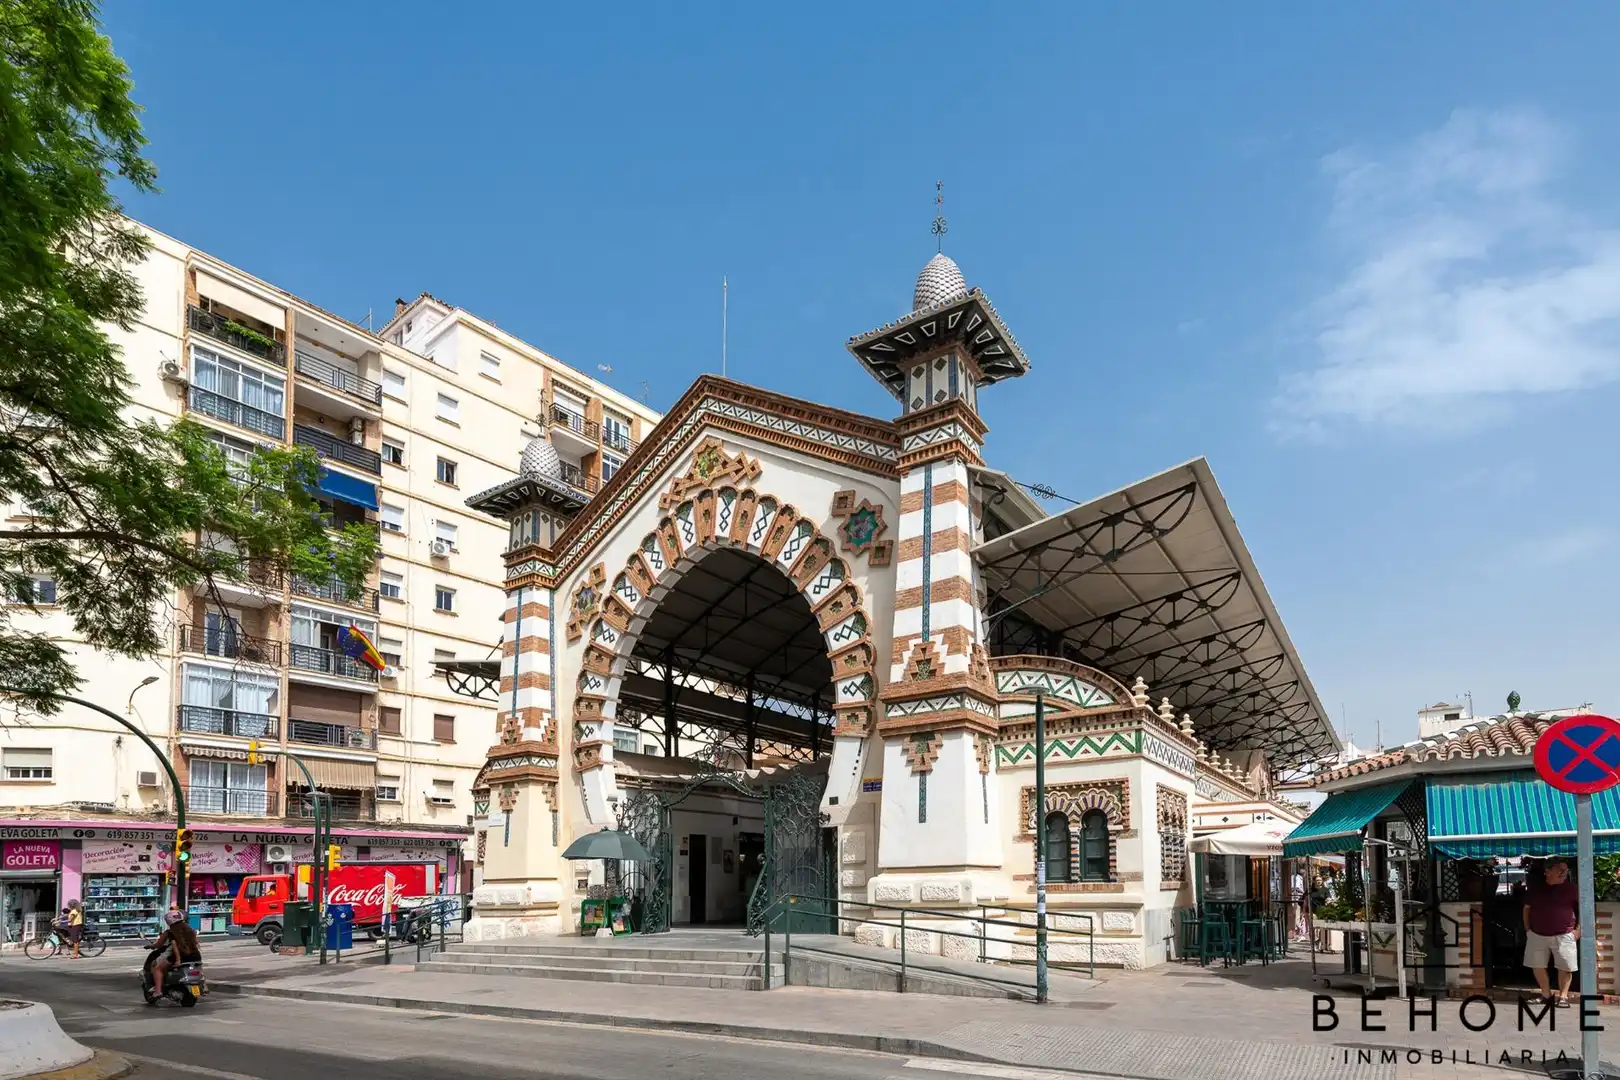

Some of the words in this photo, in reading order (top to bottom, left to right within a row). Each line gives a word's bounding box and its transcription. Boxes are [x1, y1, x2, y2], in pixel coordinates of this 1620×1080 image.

[21, 829, 59, 838] GOLETA
[107, 831, 122, 839] 619
[124, 831, 139, 840] 857
[140, 832, 154, 840] 351
[195, 833, 208, 841] 726
[233, 834, 249, 843] LA
[256, 835, 297, 844] NUEVA
[304, 836, 348, 845] GLETA
[13, 846, 24, 854] LA
[25, 845, 50, 853] NUEVA
[6, 855, 56, 866] GOLETA
[328, 883, 408, 906] Coca-Coa
